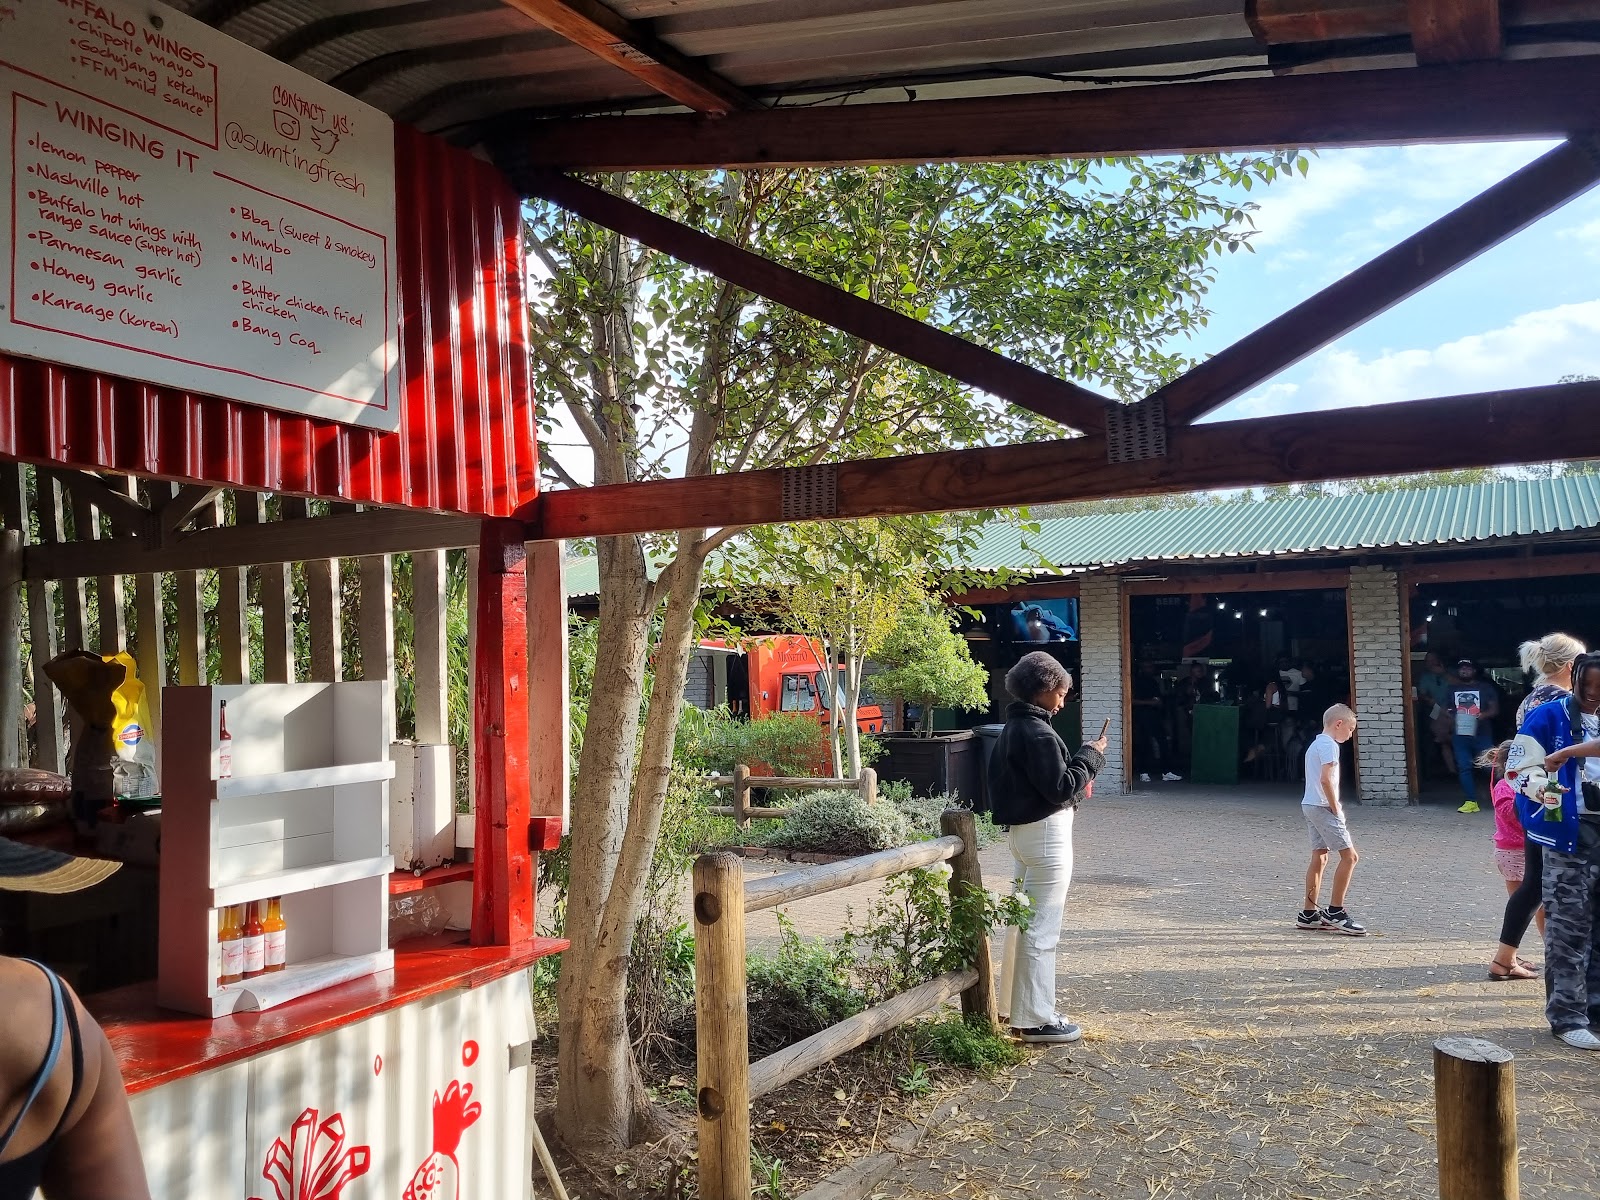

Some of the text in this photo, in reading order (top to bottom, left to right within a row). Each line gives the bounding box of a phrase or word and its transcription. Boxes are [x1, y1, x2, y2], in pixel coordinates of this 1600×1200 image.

[78, 20, 193, 78] Chipotle mayo
[78, 39, 214, 108] Gochujang ketchup
[143, 28, 206, 69] WINGS
[80, 55, 204, 117] FFM mild sauce
[272, 85, 355, 137] CONTACT US:
[36, 132, 141, 183] lemon pepper
[55, 101, 200, 173] WINGING IT
[224, 121, 366, 198] @sumtingfresh
[36, 162, 145, 208] Nashville hot
[38, 189, 202, 252] Buffalo hot wings with
[38, 207, 202, 268] range sauce (super hot)
[240, 207, 275, 233] Bbq
[324, 235, 333, 250] &
[334, 241, 376, 269] smokey
[241, 230, 292, 256] Mumbo
[38, 230, 183, 287] Parmesan garlic
[43, 257, 154, 303] Honey garlic
[242, 255, 274, 275] Mild
[42, 289, 180, 339] Karaage (Korean)
[242, 280, 363, 329] Butter chicken fried
[242, 299, 298, 323] chicken
[242, 317, 322, 354] Bang Coq
